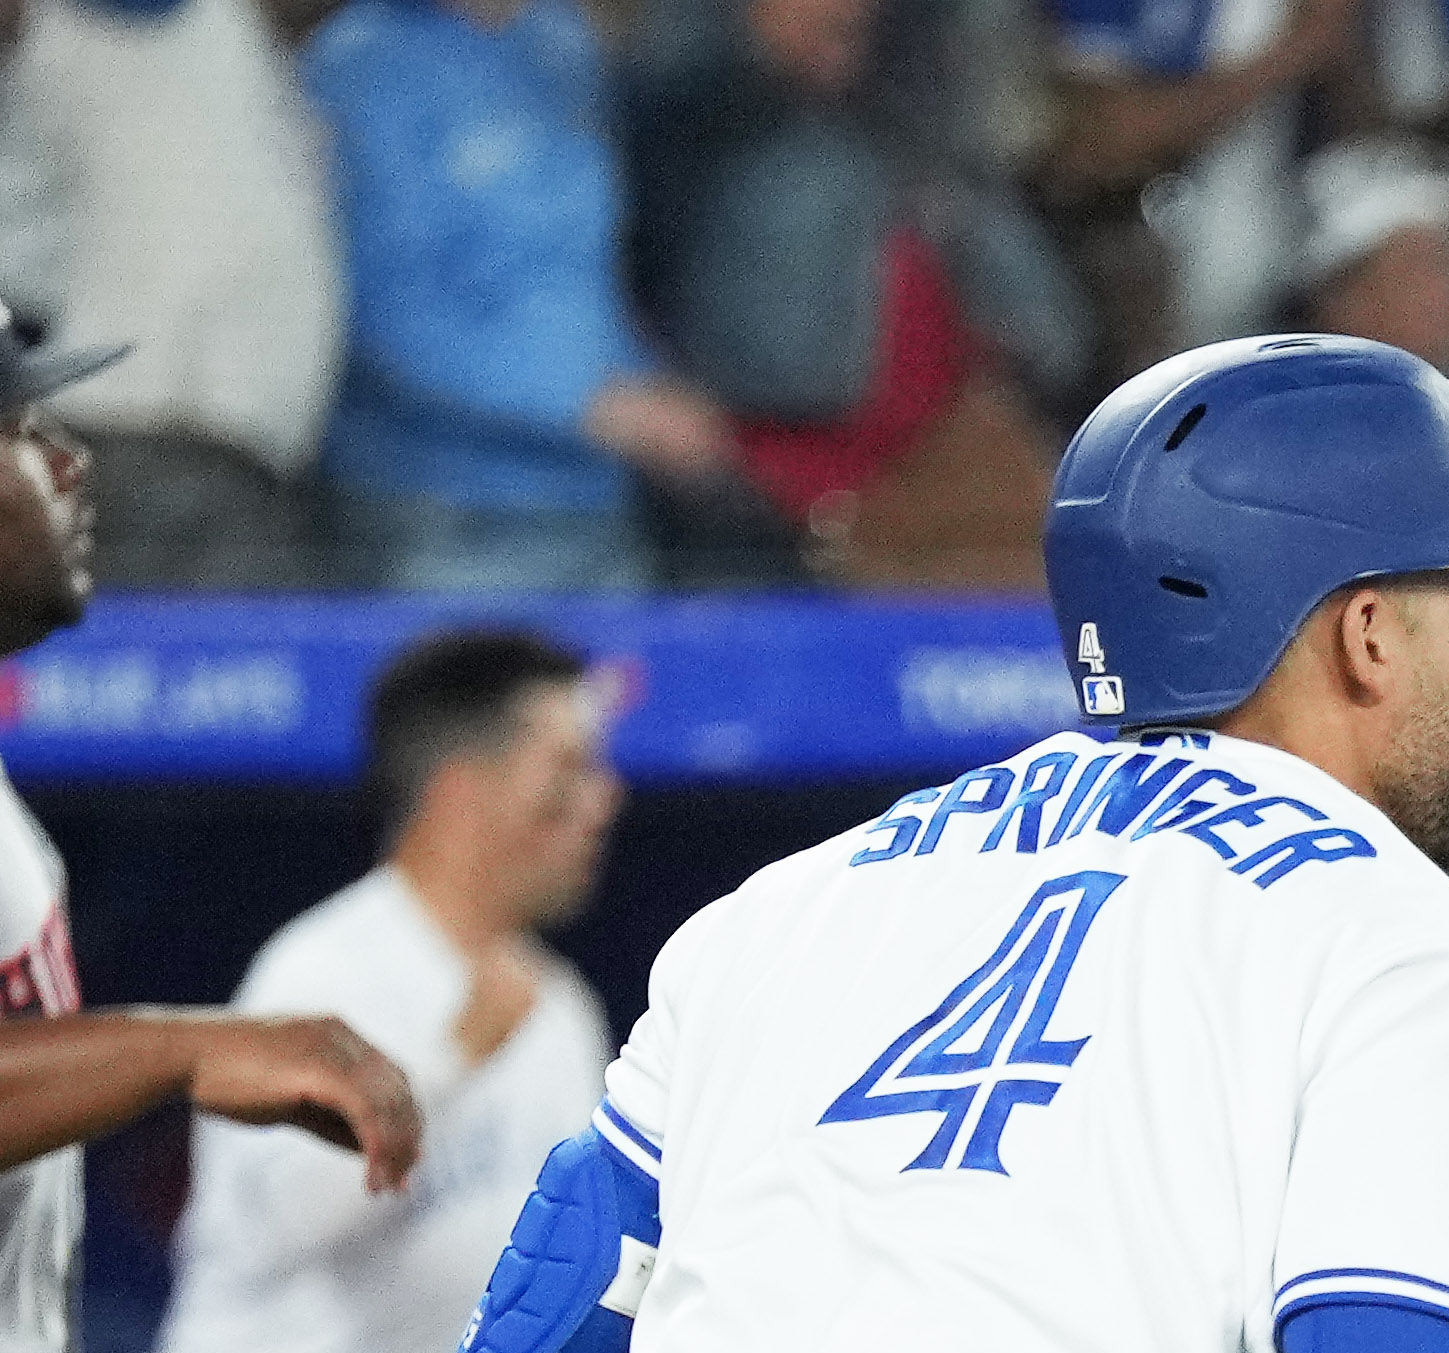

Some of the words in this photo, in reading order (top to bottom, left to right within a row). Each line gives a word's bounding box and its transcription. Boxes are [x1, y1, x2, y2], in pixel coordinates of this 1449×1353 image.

[1078, 622, 1105, 674] 4
[850, 751, 1377, 889] SPRINGER
[816, 870, 1128, 1177] 4
